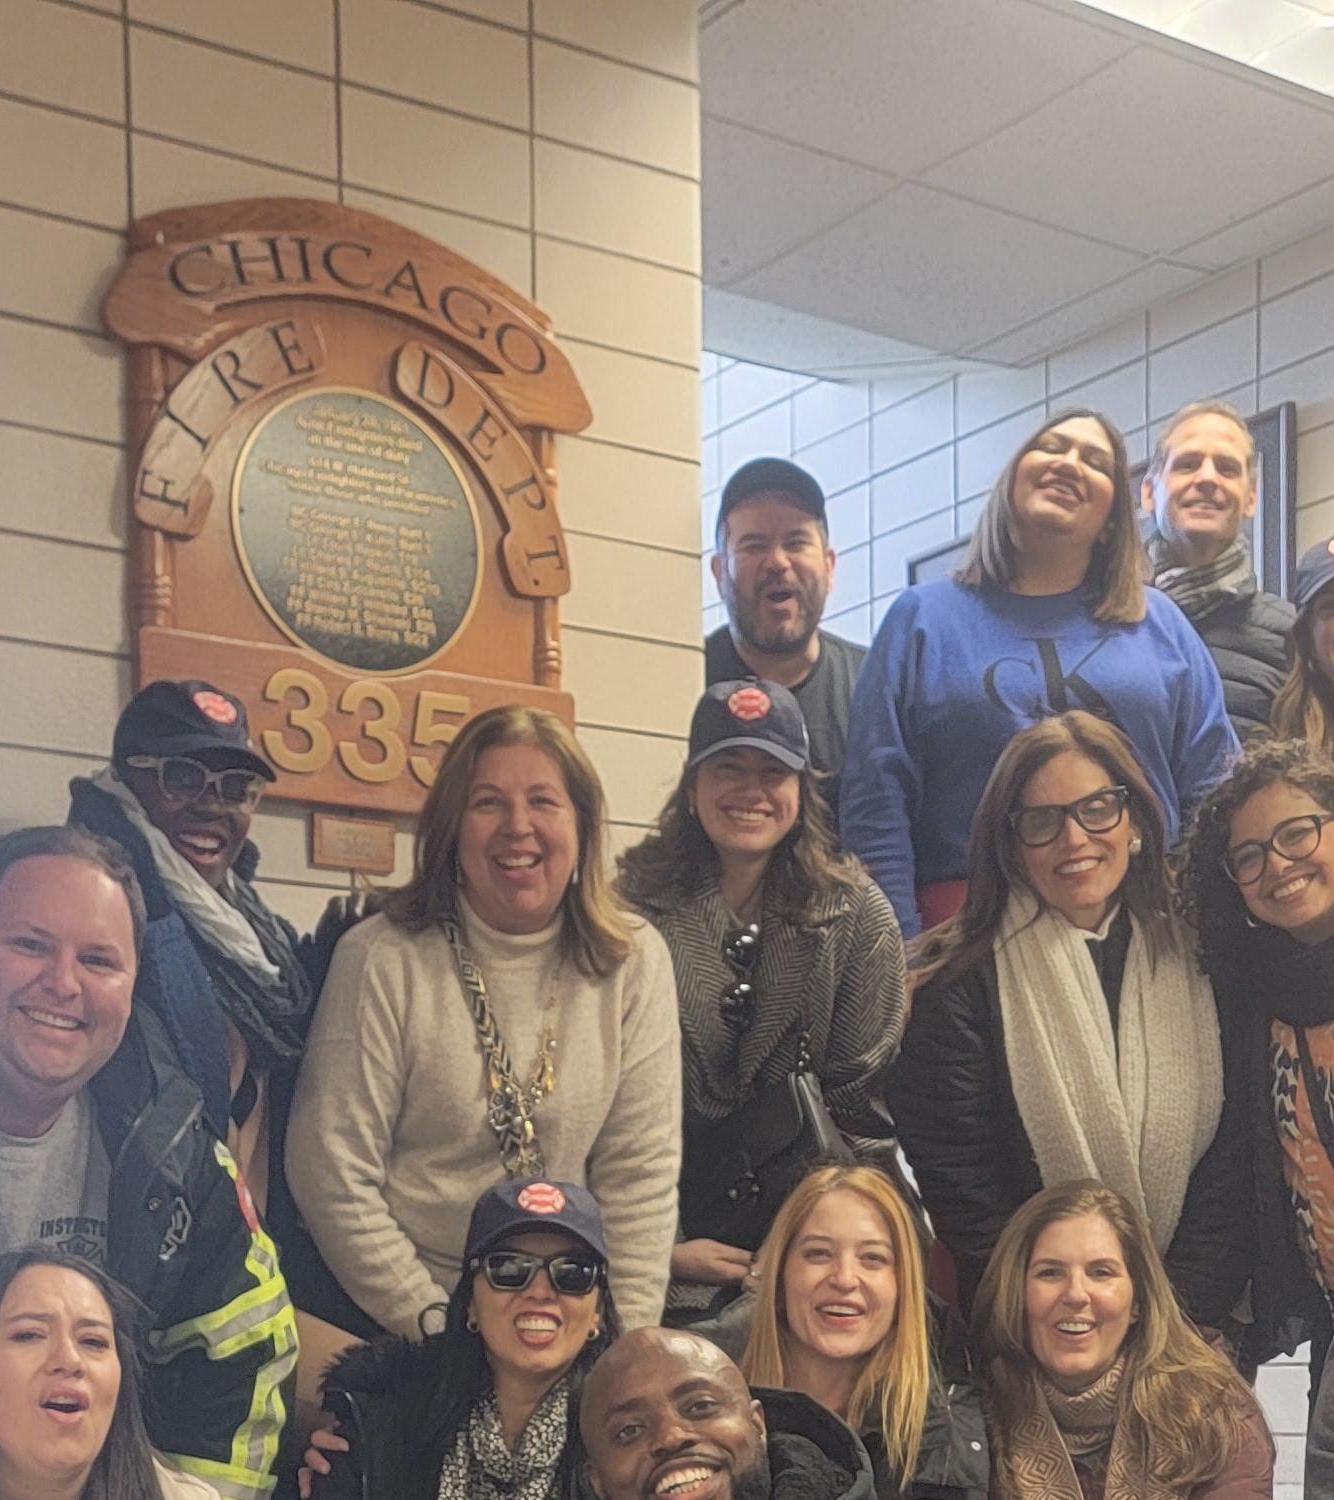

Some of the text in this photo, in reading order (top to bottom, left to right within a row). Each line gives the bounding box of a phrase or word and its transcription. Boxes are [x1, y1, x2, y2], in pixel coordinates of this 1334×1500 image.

[168, 236, 547, 375] CHICAGO
[139, 319, 315, 518] FIRE
[261, 667, 471, 788] 335
